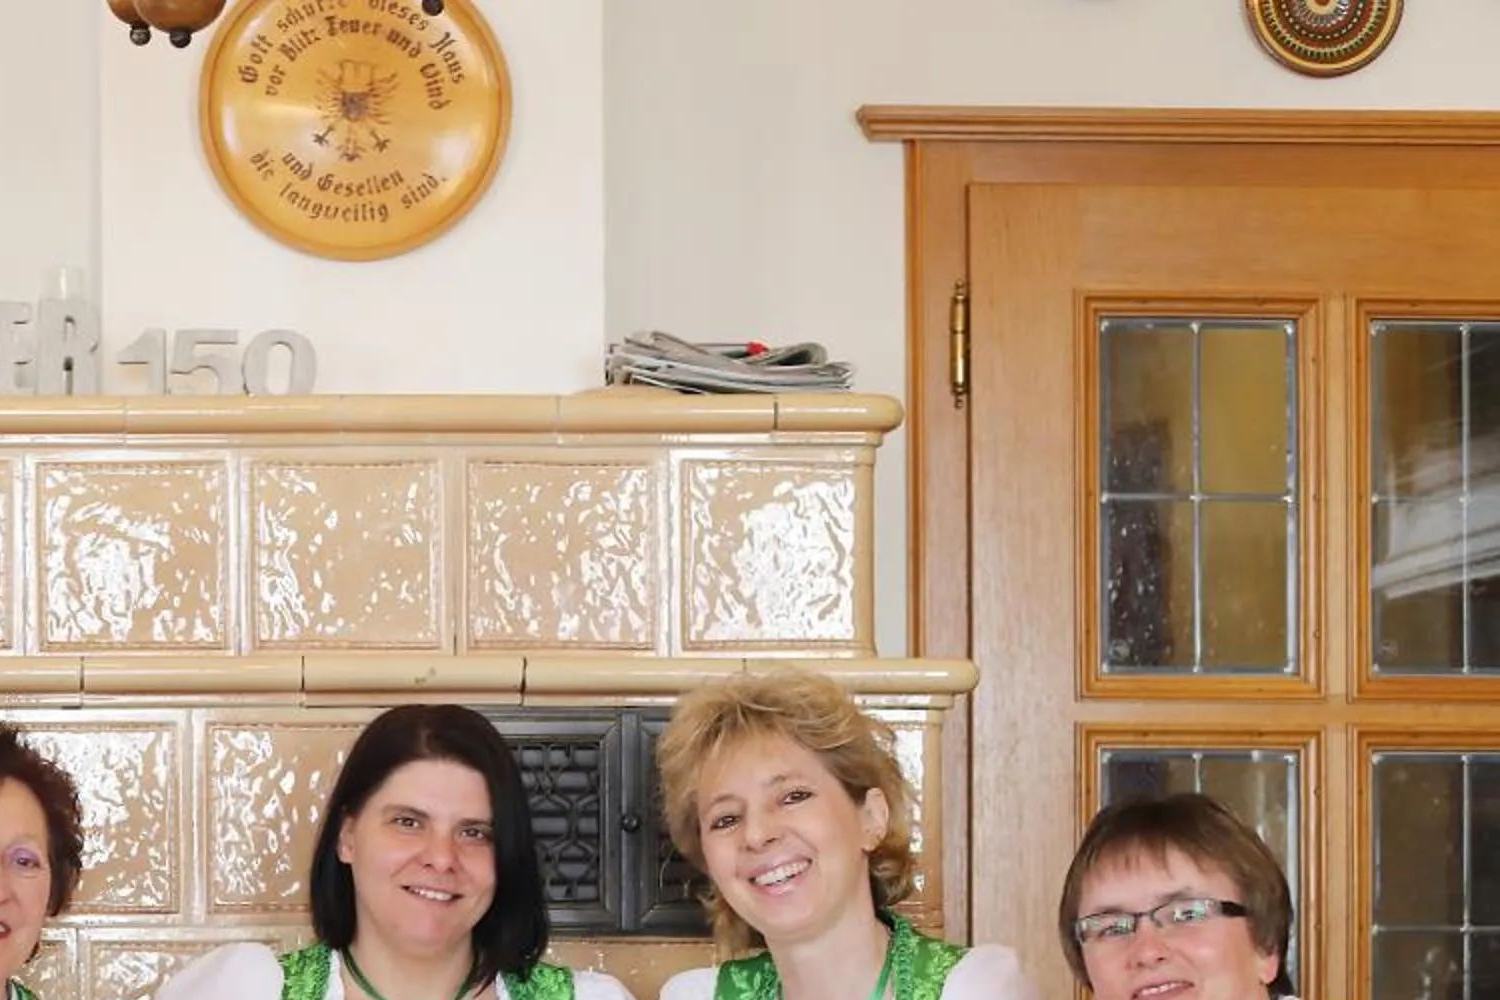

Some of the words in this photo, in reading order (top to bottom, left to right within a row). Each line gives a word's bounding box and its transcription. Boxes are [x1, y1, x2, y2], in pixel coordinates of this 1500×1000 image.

[265, 64, 286, 97] vor
[385, 27, 422, 59] und
[282, 152, 313, 182] und
